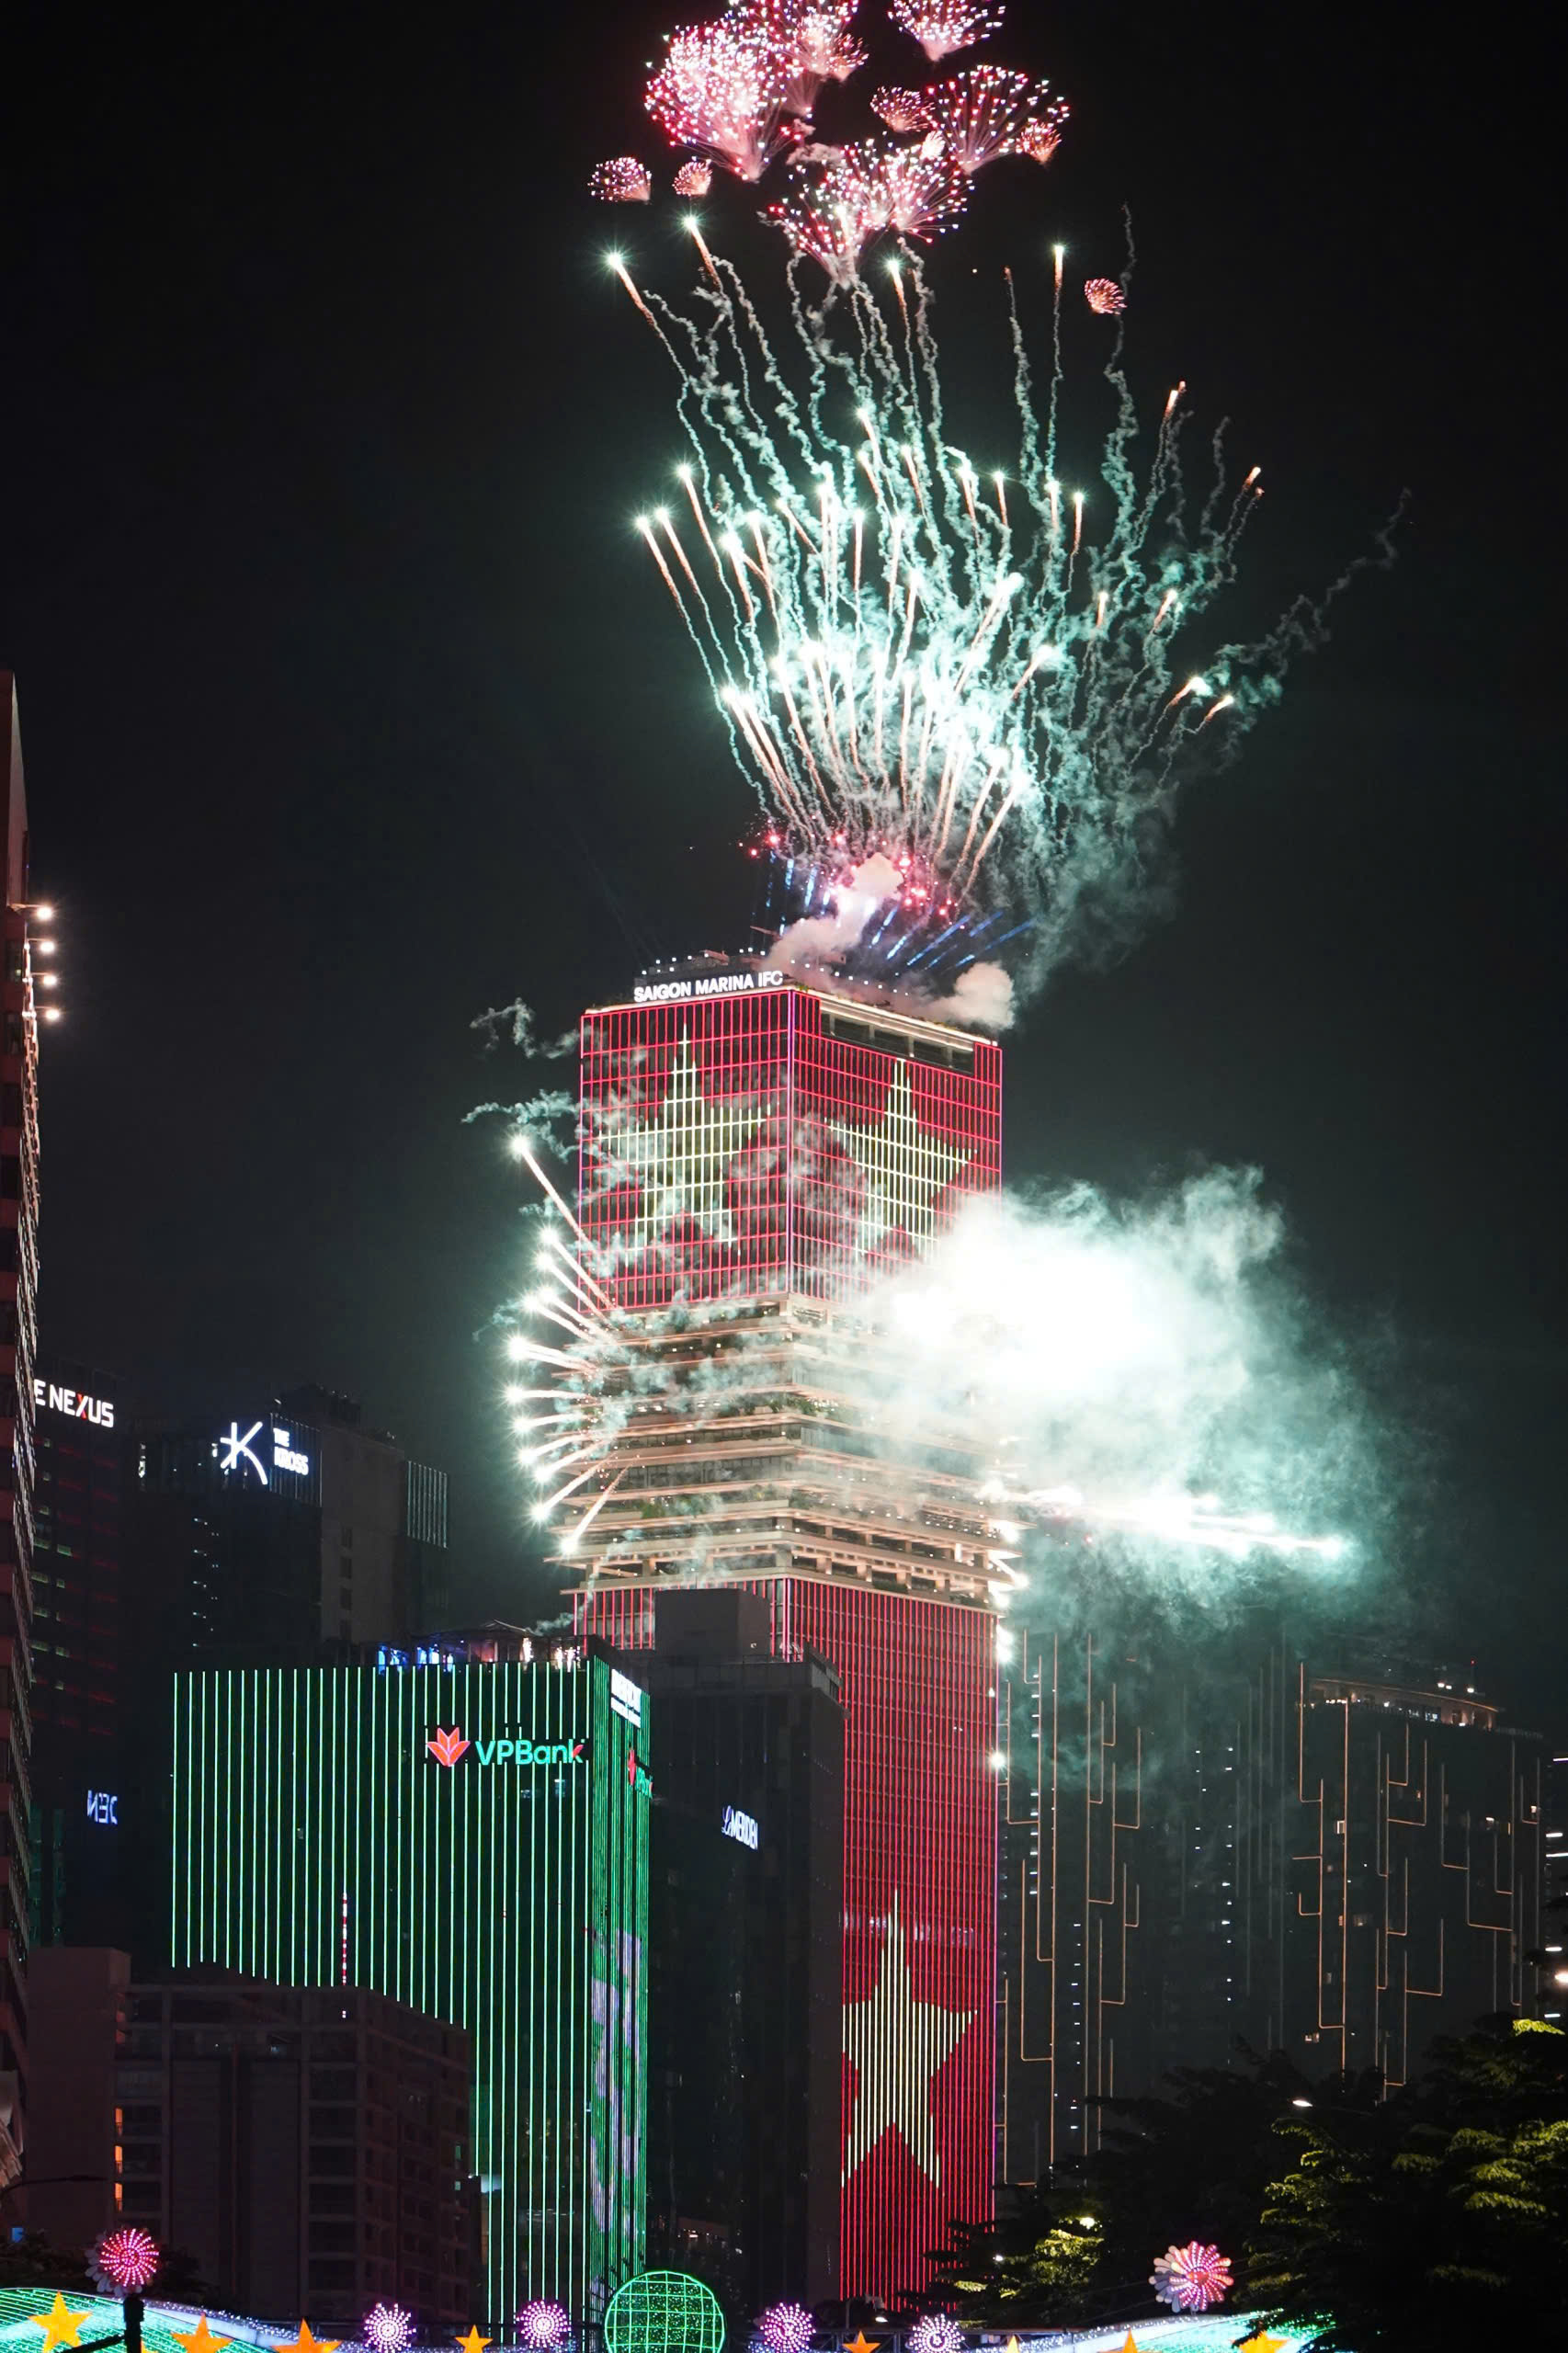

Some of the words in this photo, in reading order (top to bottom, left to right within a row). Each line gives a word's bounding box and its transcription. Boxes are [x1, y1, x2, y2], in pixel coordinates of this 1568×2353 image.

[634, 982, 691, 1003] SAIGON
[695, 973, 755, 995] MARINA
[757, 970, 783, 987] IFC
[49, 1383, 114, 1428] NEXUS
[274, 1447, 309, 1475] KROSS
[475, 1738, 585, 1766] VPBank
